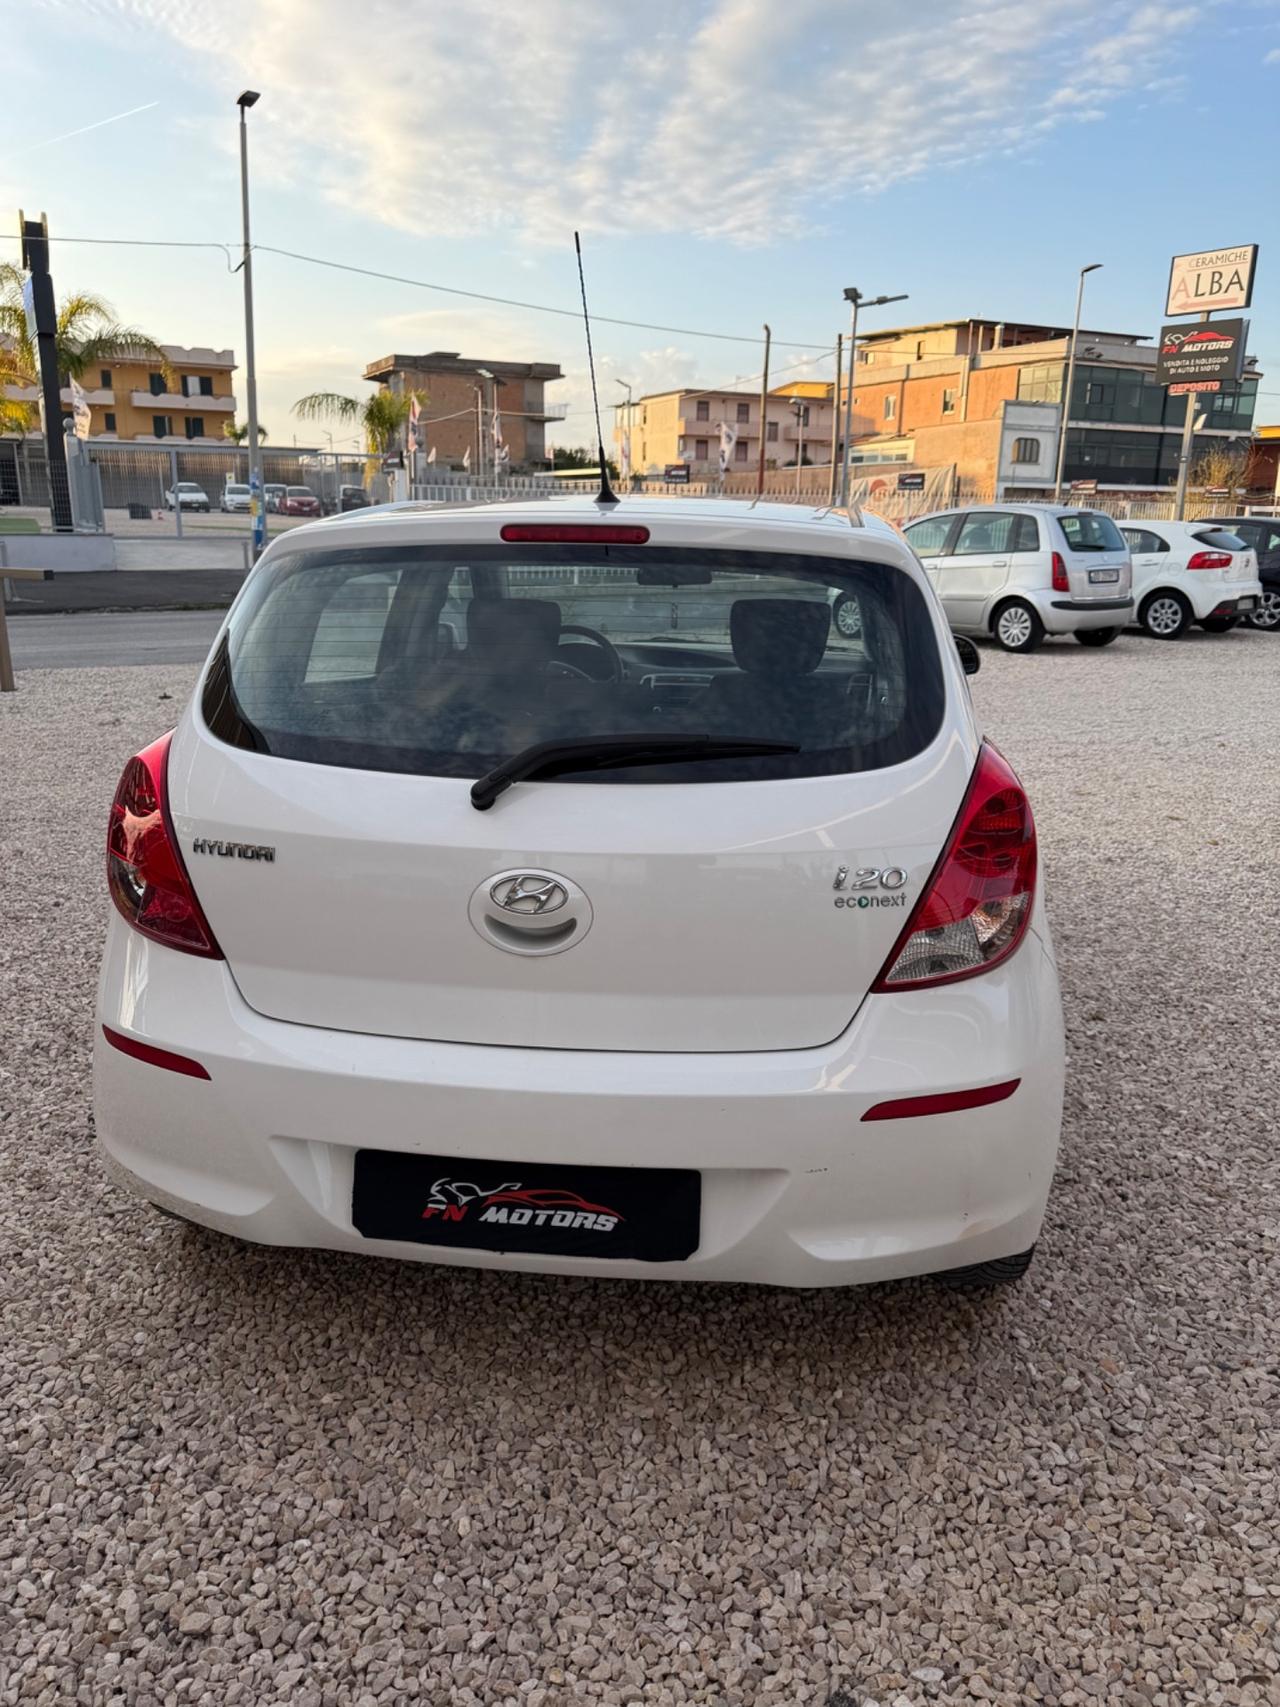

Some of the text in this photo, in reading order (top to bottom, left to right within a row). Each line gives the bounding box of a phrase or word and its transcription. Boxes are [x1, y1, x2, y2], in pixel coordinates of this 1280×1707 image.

[1189, 250, 1248, 268] CERAMICHE
[1172, 268, 1245, 300] ALBA
[1162, 340, 1234, 354] FN MOTORS
[1163, 359, 1190, 367] VENDITA
[1195, 356, 1229, 365] NOLEGGIO
[1169, 381, 1221, 393] DEPOSITO
[193, 838, 276, 862] HYUNDAI
[834, 892, 907, 908] econext
[422, 1204, 619, 1232] FN MOTORS
